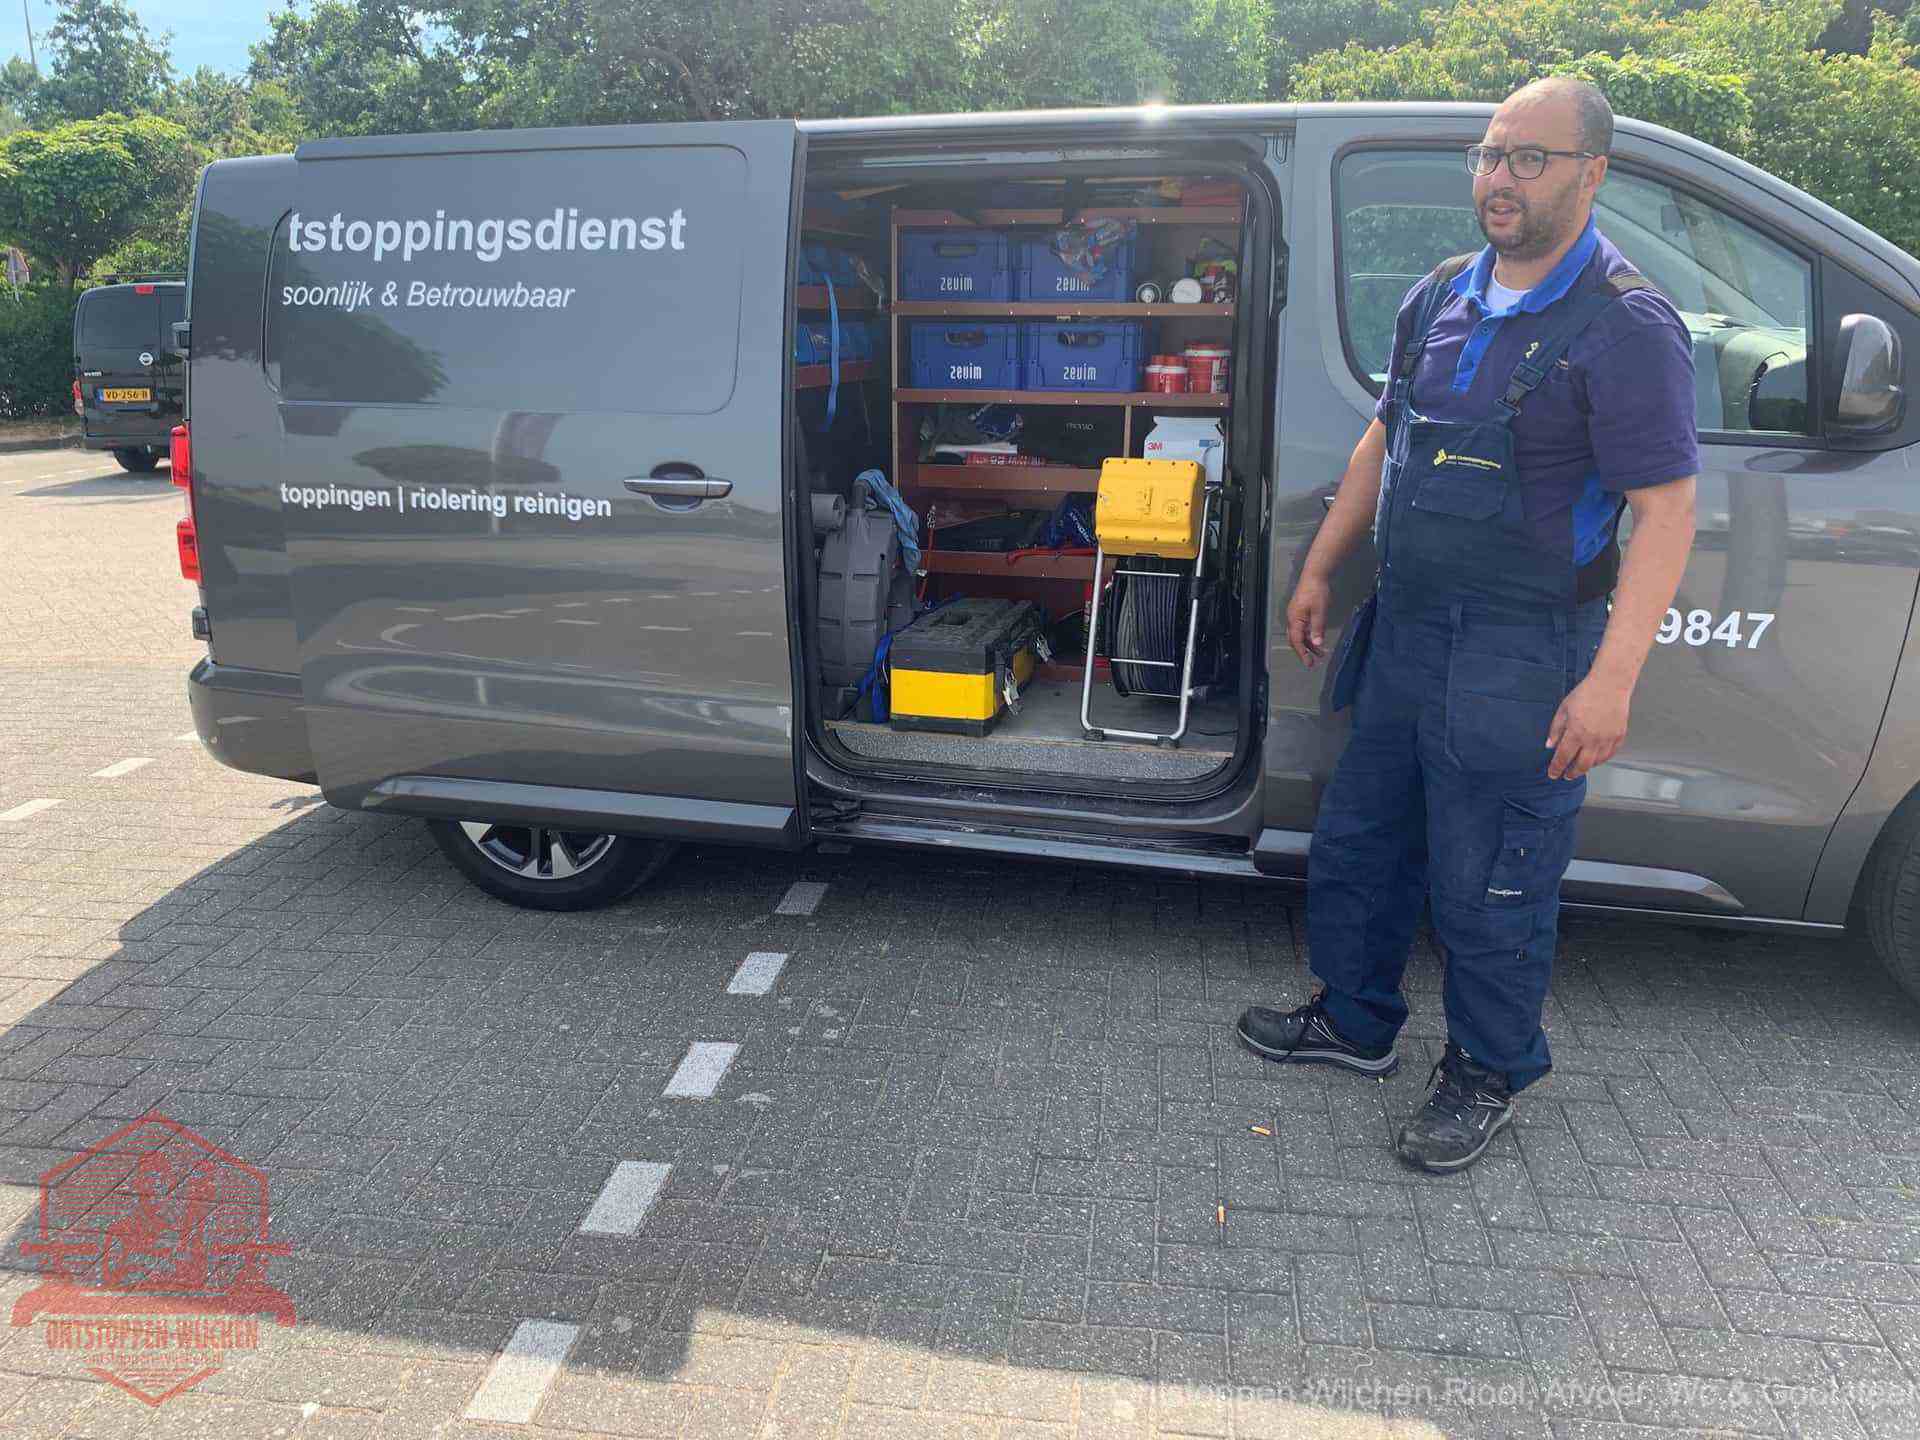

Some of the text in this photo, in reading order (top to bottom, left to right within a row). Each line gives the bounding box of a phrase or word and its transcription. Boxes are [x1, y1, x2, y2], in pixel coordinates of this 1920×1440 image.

[289, 208, 687, 262] tstoppingsdienst
[282, 280, 576, 312] soonlijk & Betrouwbaar
[1147, 441, 1163, 451] 3M
[280, 482, 391, 511] toppingen
[410, 487, 507, 517] riolering
[514, 491, 612, 521] reinigen
[1655, 607, 1776, 649] 9847
